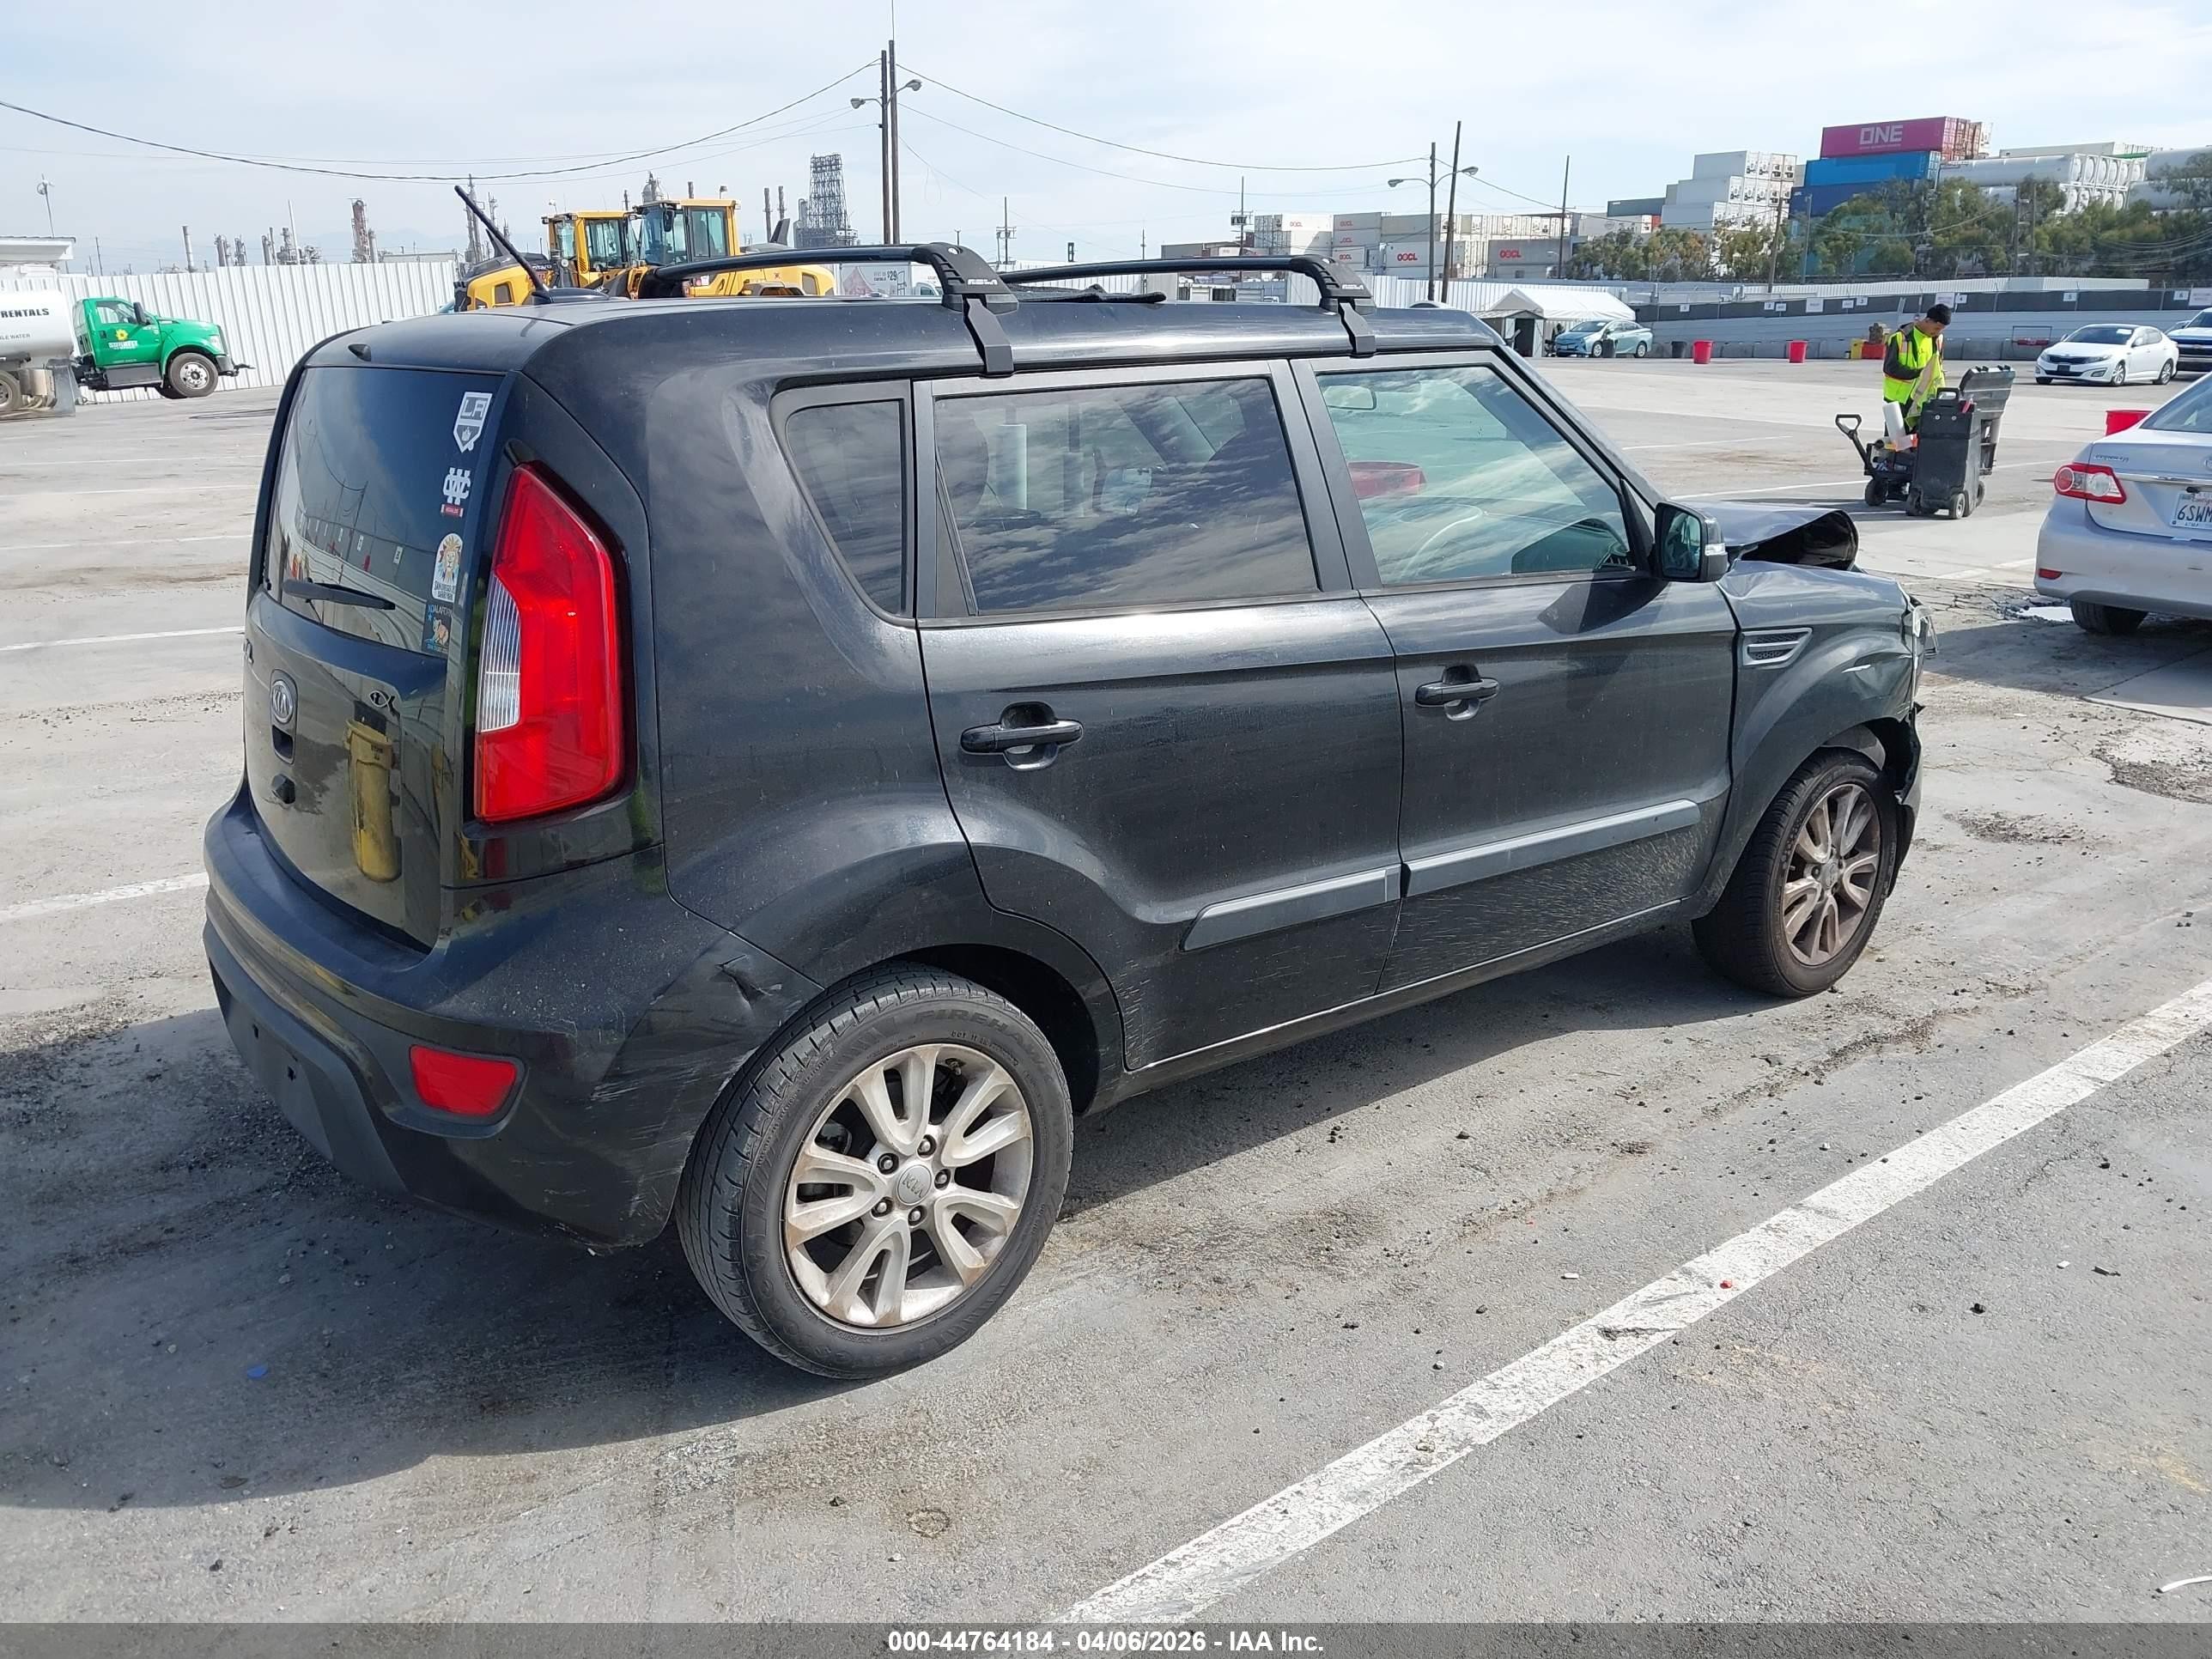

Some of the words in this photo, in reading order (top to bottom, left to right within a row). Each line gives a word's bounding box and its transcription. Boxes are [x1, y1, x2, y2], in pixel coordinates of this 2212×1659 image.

[1859, 125, 1904, 145] ONE
[1397, 252, 1419, 261] OOCL
[1499, 249, 1522, 258] OOCL
[0, 308, 50, 319] RENTALS
[902, 1173, 923, 1199] KIA
